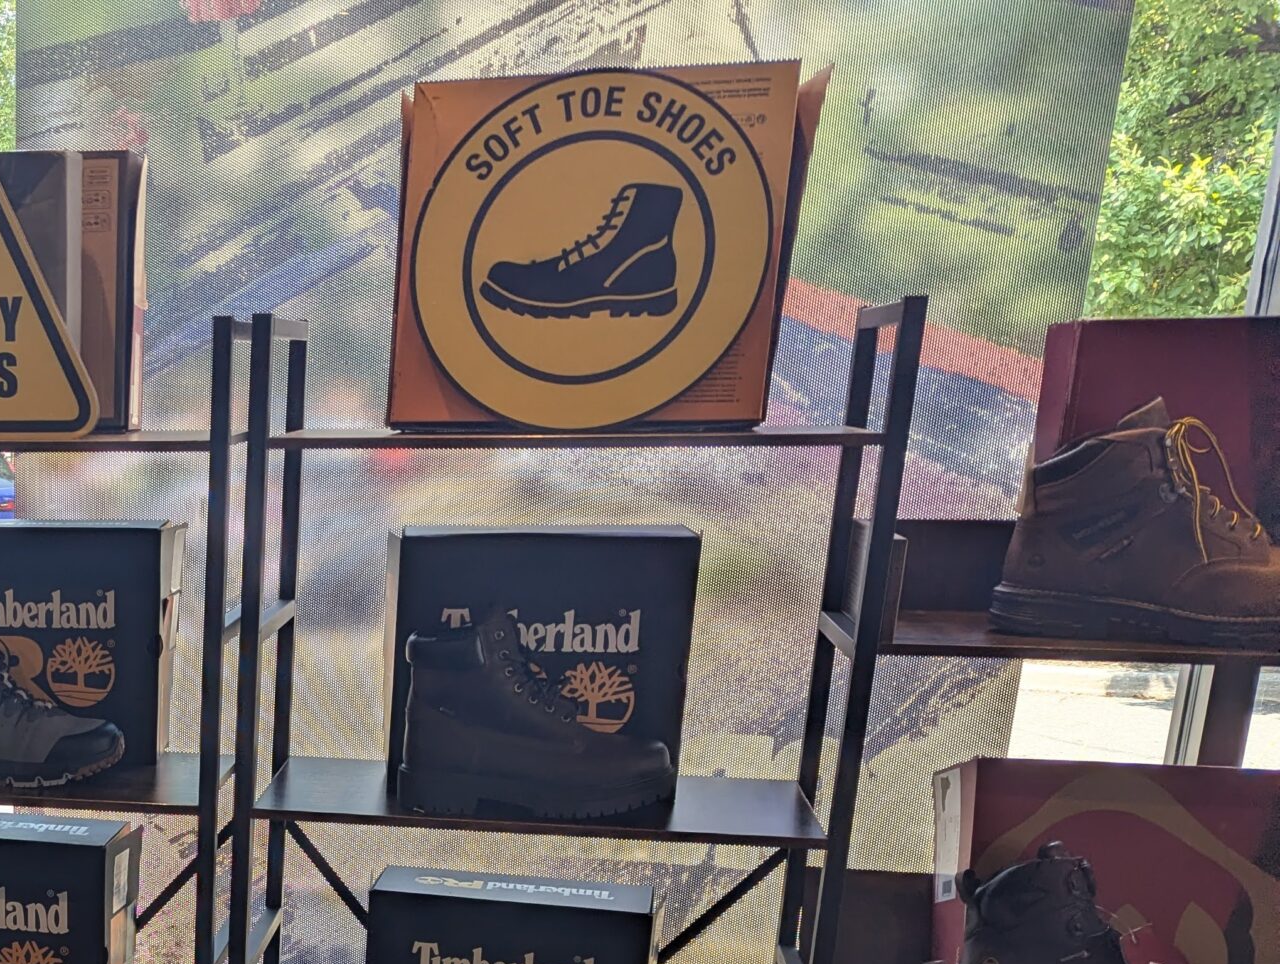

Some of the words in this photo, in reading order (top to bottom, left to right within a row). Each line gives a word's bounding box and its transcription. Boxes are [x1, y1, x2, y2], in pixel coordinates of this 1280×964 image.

[464, 103, 542, 180] SOFT
[557, 86, 626, 122] TOE
[636, 91, 737, 176] SHOES
[486, 879, 614, 900] Timberland
